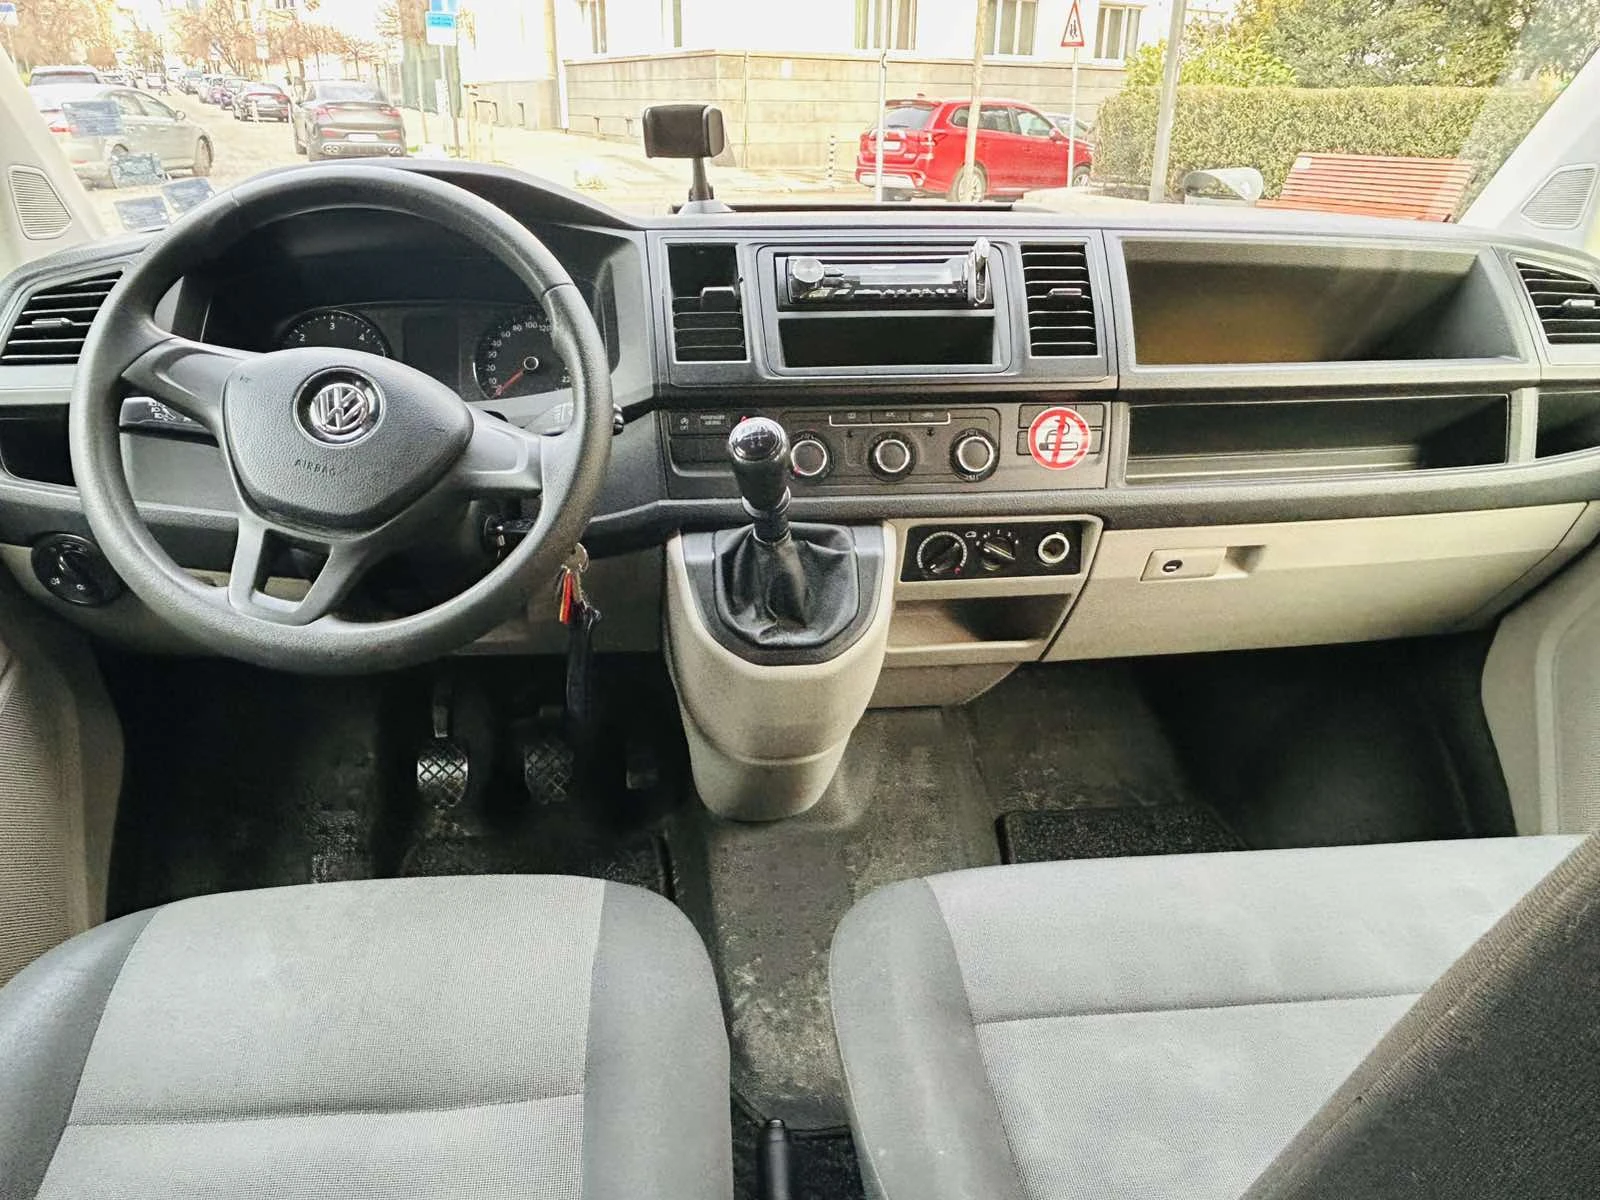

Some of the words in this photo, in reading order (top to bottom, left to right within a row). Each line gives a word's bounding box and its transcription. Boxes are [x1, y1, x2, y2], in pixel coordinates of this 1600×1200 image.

[329, 322, 336, 331] 3
[524, 321, 538, 329] 100
[299, 333, 306, 342] 2
[358, 333, 365, 341] 4
[309, 382, 369, 432] VW
